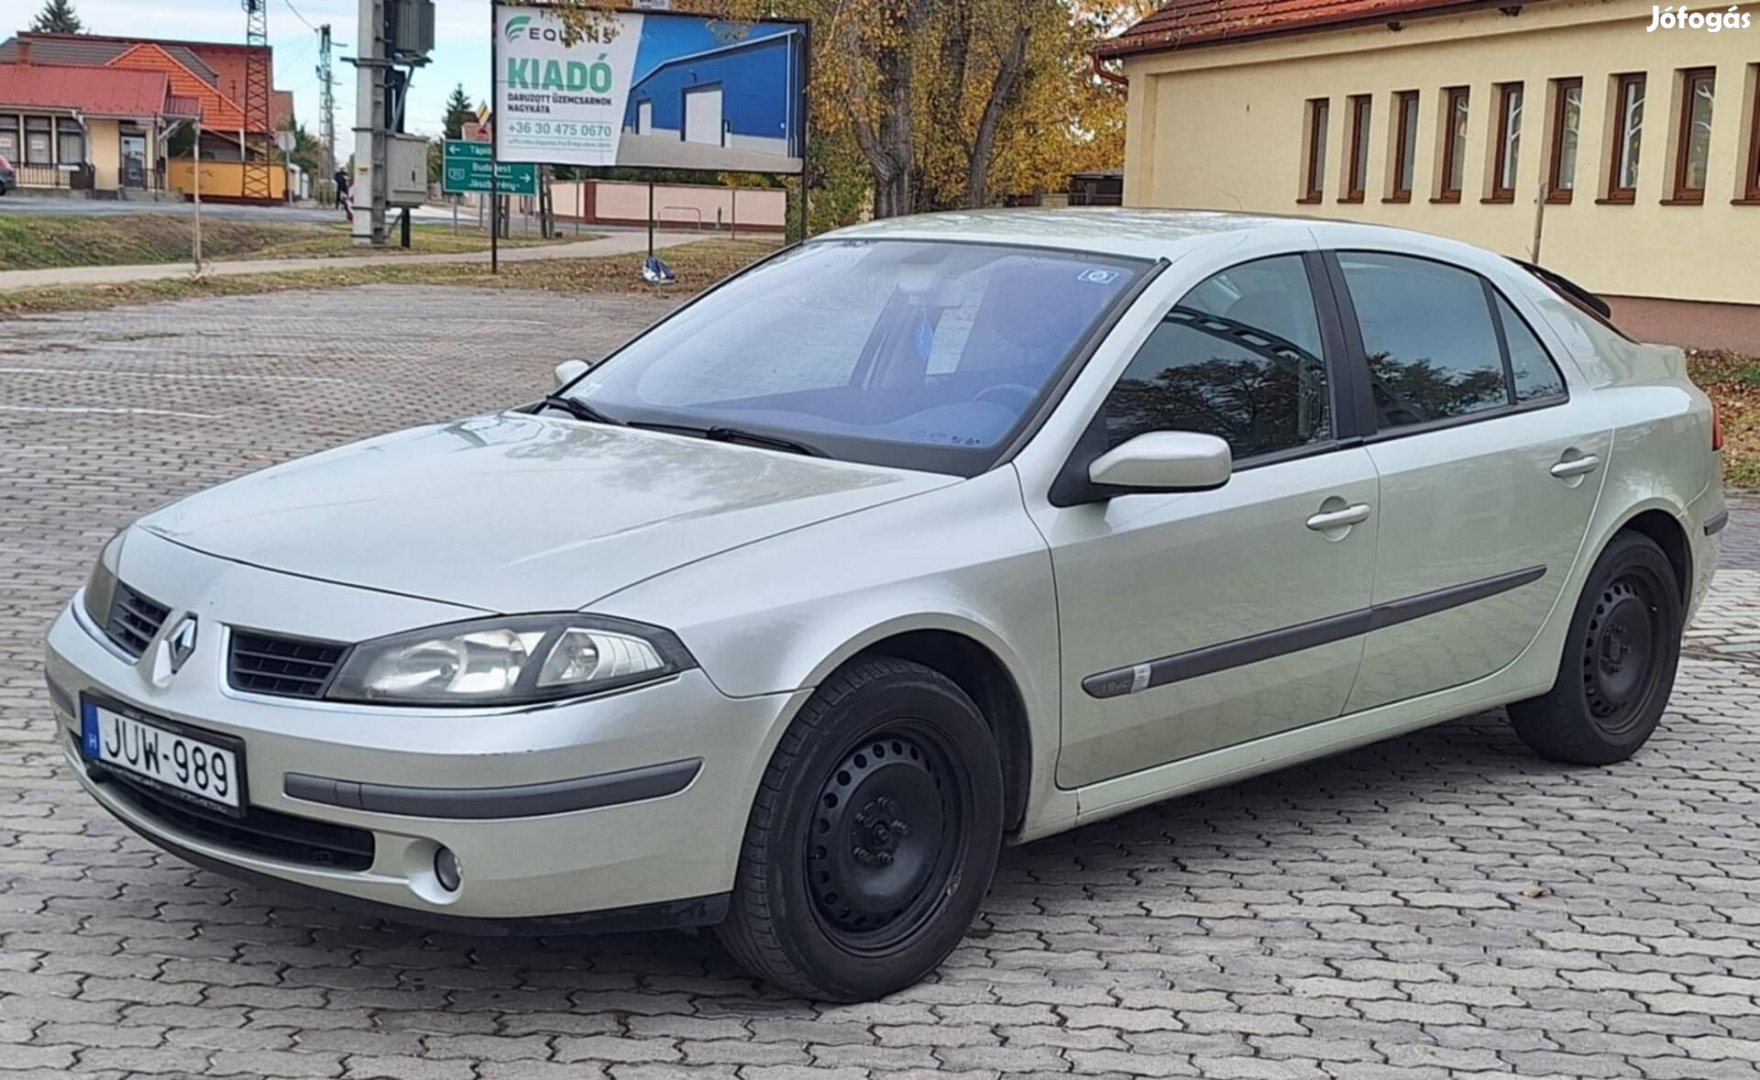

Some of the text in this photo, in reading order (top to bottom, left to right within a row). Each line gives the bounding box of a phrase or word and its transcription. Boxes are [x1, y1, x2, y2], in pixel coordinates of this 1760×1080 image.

[508, 53, 612, 93] KIADÓ
[507, 92, 612, 105] DARUZOTT ÜZEMCSARNOK
[507, 102, 550, 113] NAGYKÁTA
[508, 122, 612, 137] +36 30 475 0670
[472, 162, 511, 173] Budaest
[469, 179, 516, 191] Jászbrény
[89, 733, 98, 750] H
[105, 718, 228, 797] JUW-989
